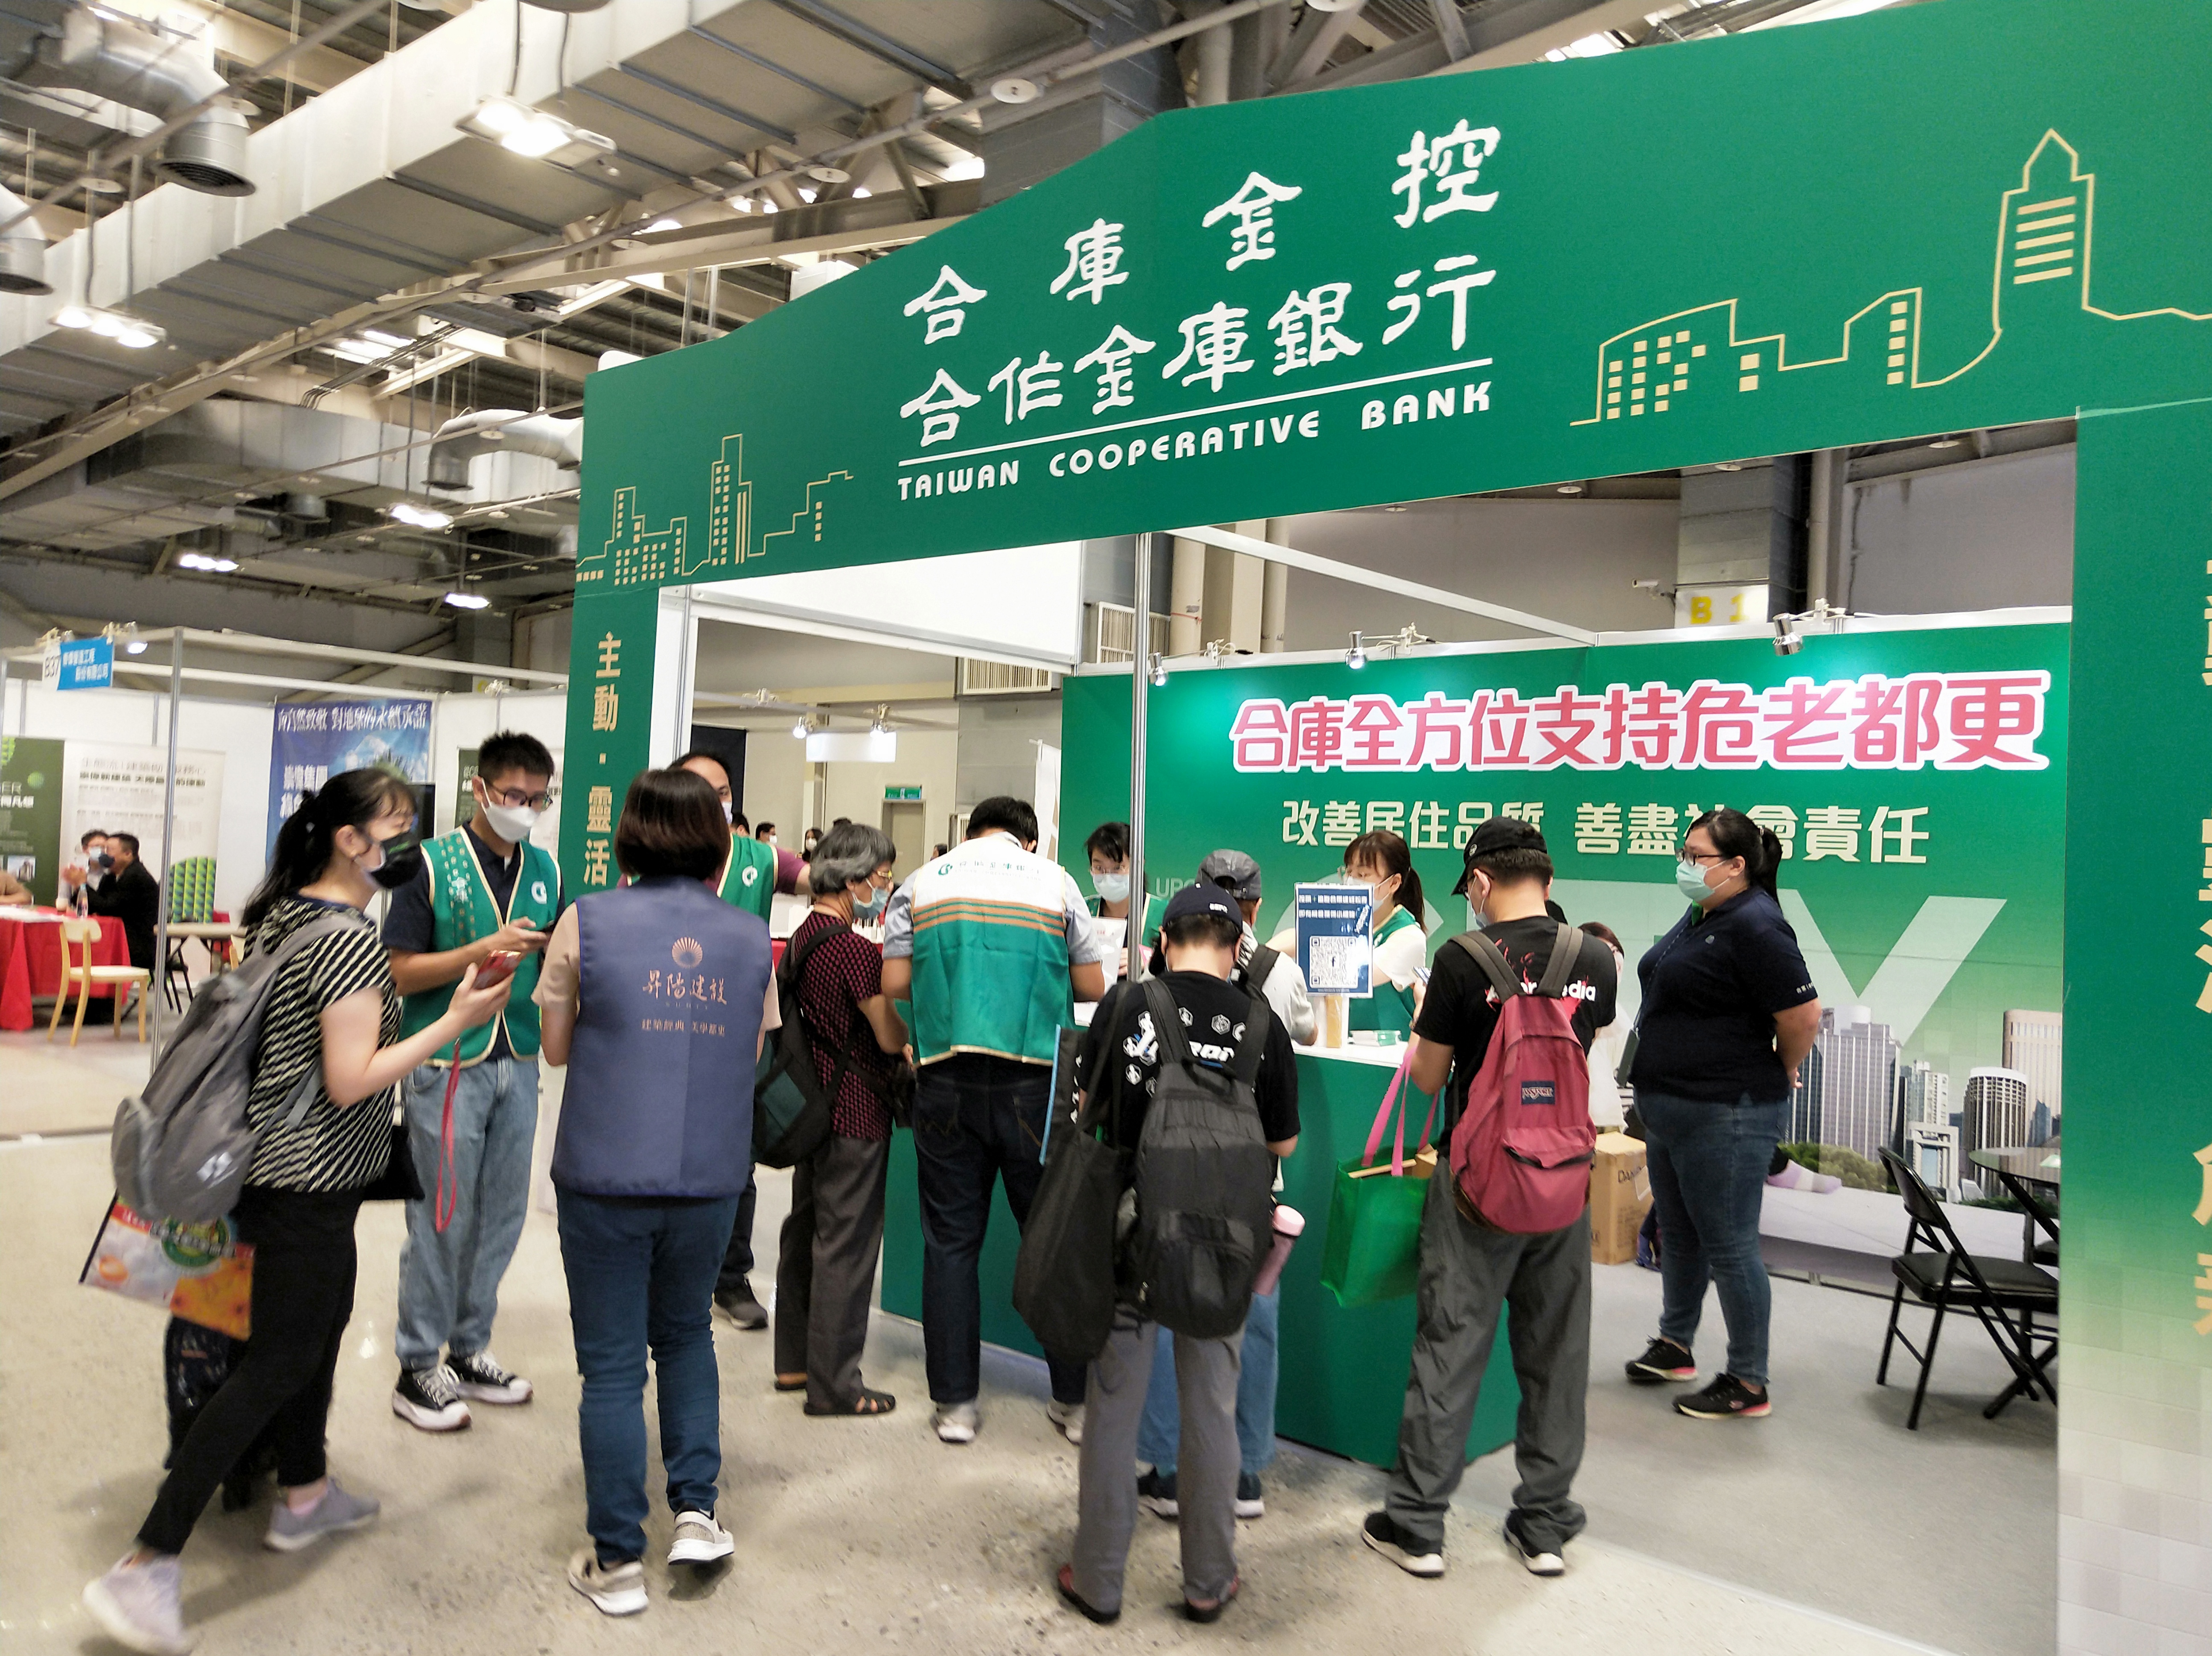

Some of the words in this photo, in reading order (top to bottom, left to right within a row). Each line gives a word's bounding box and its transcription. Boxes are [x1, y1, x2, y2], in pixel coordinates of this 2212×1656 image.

[904, 119, 1501, 345] 合庫金控
[900, 254, 1496, 447] 合作金庫銀行
[898, 460, 1019, 501] TAIWAN
[1049, 410, 1319, 477] COOPERATIVE
[1362, 381, 1492, 430] BANK
[44, 655, 61, 678] B37
[1233, 676, 2043, 767] 合庫全方位支持危老都更
[1574, 802, 1930, 863] 善盡會責任
